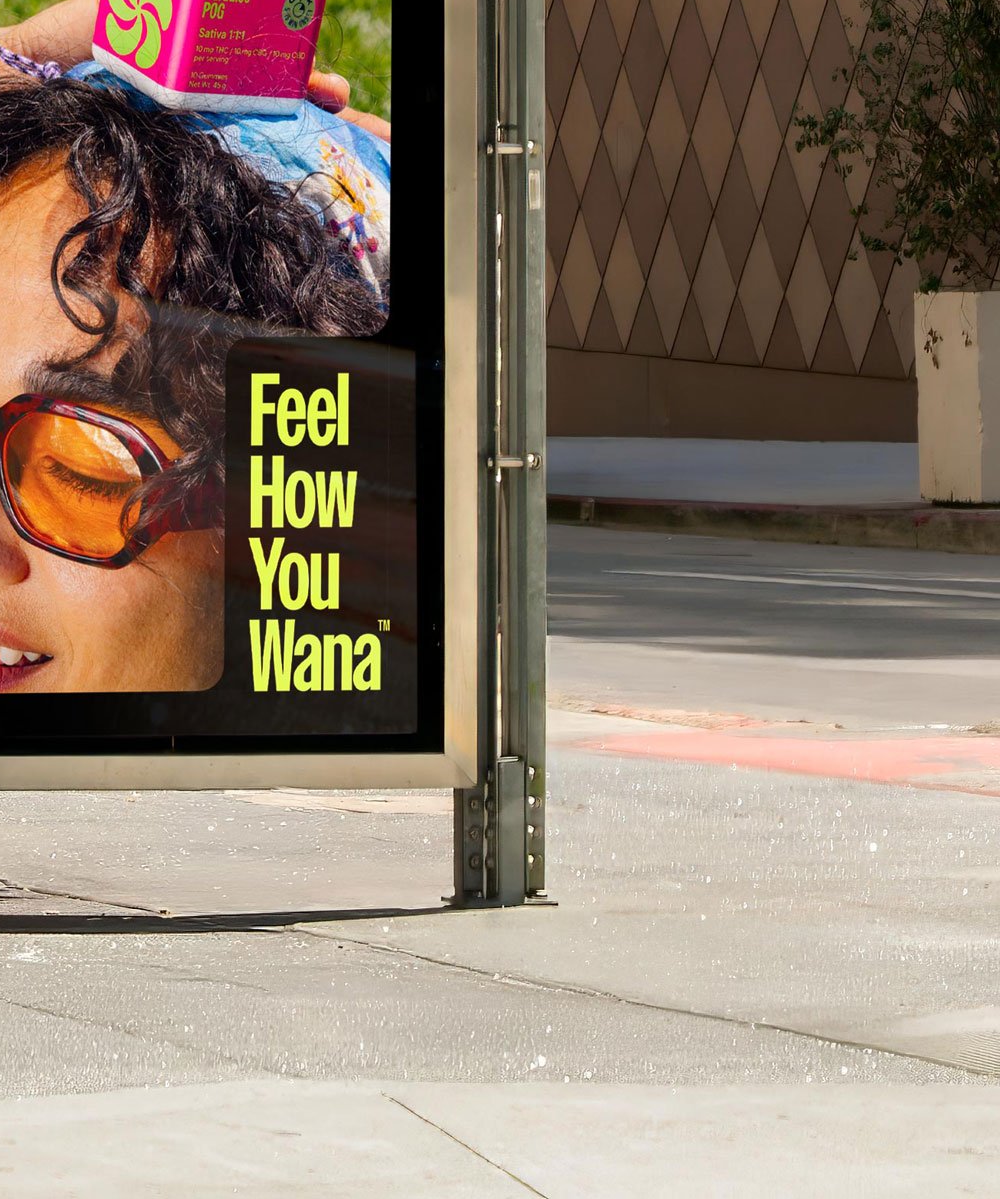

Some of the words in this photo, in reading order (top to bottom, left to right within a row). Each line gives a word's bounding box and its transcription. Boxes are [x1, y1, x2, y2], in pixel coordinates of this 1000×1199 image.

[198, 27, 227, 40] Sativa
[201, 1, 226, 20] POG
[250, 372, 350, 447] Feel
[250, 455, 358, 529] How
[248, 536, 340, 611] You
[249, 618, 382, 693] Wana
